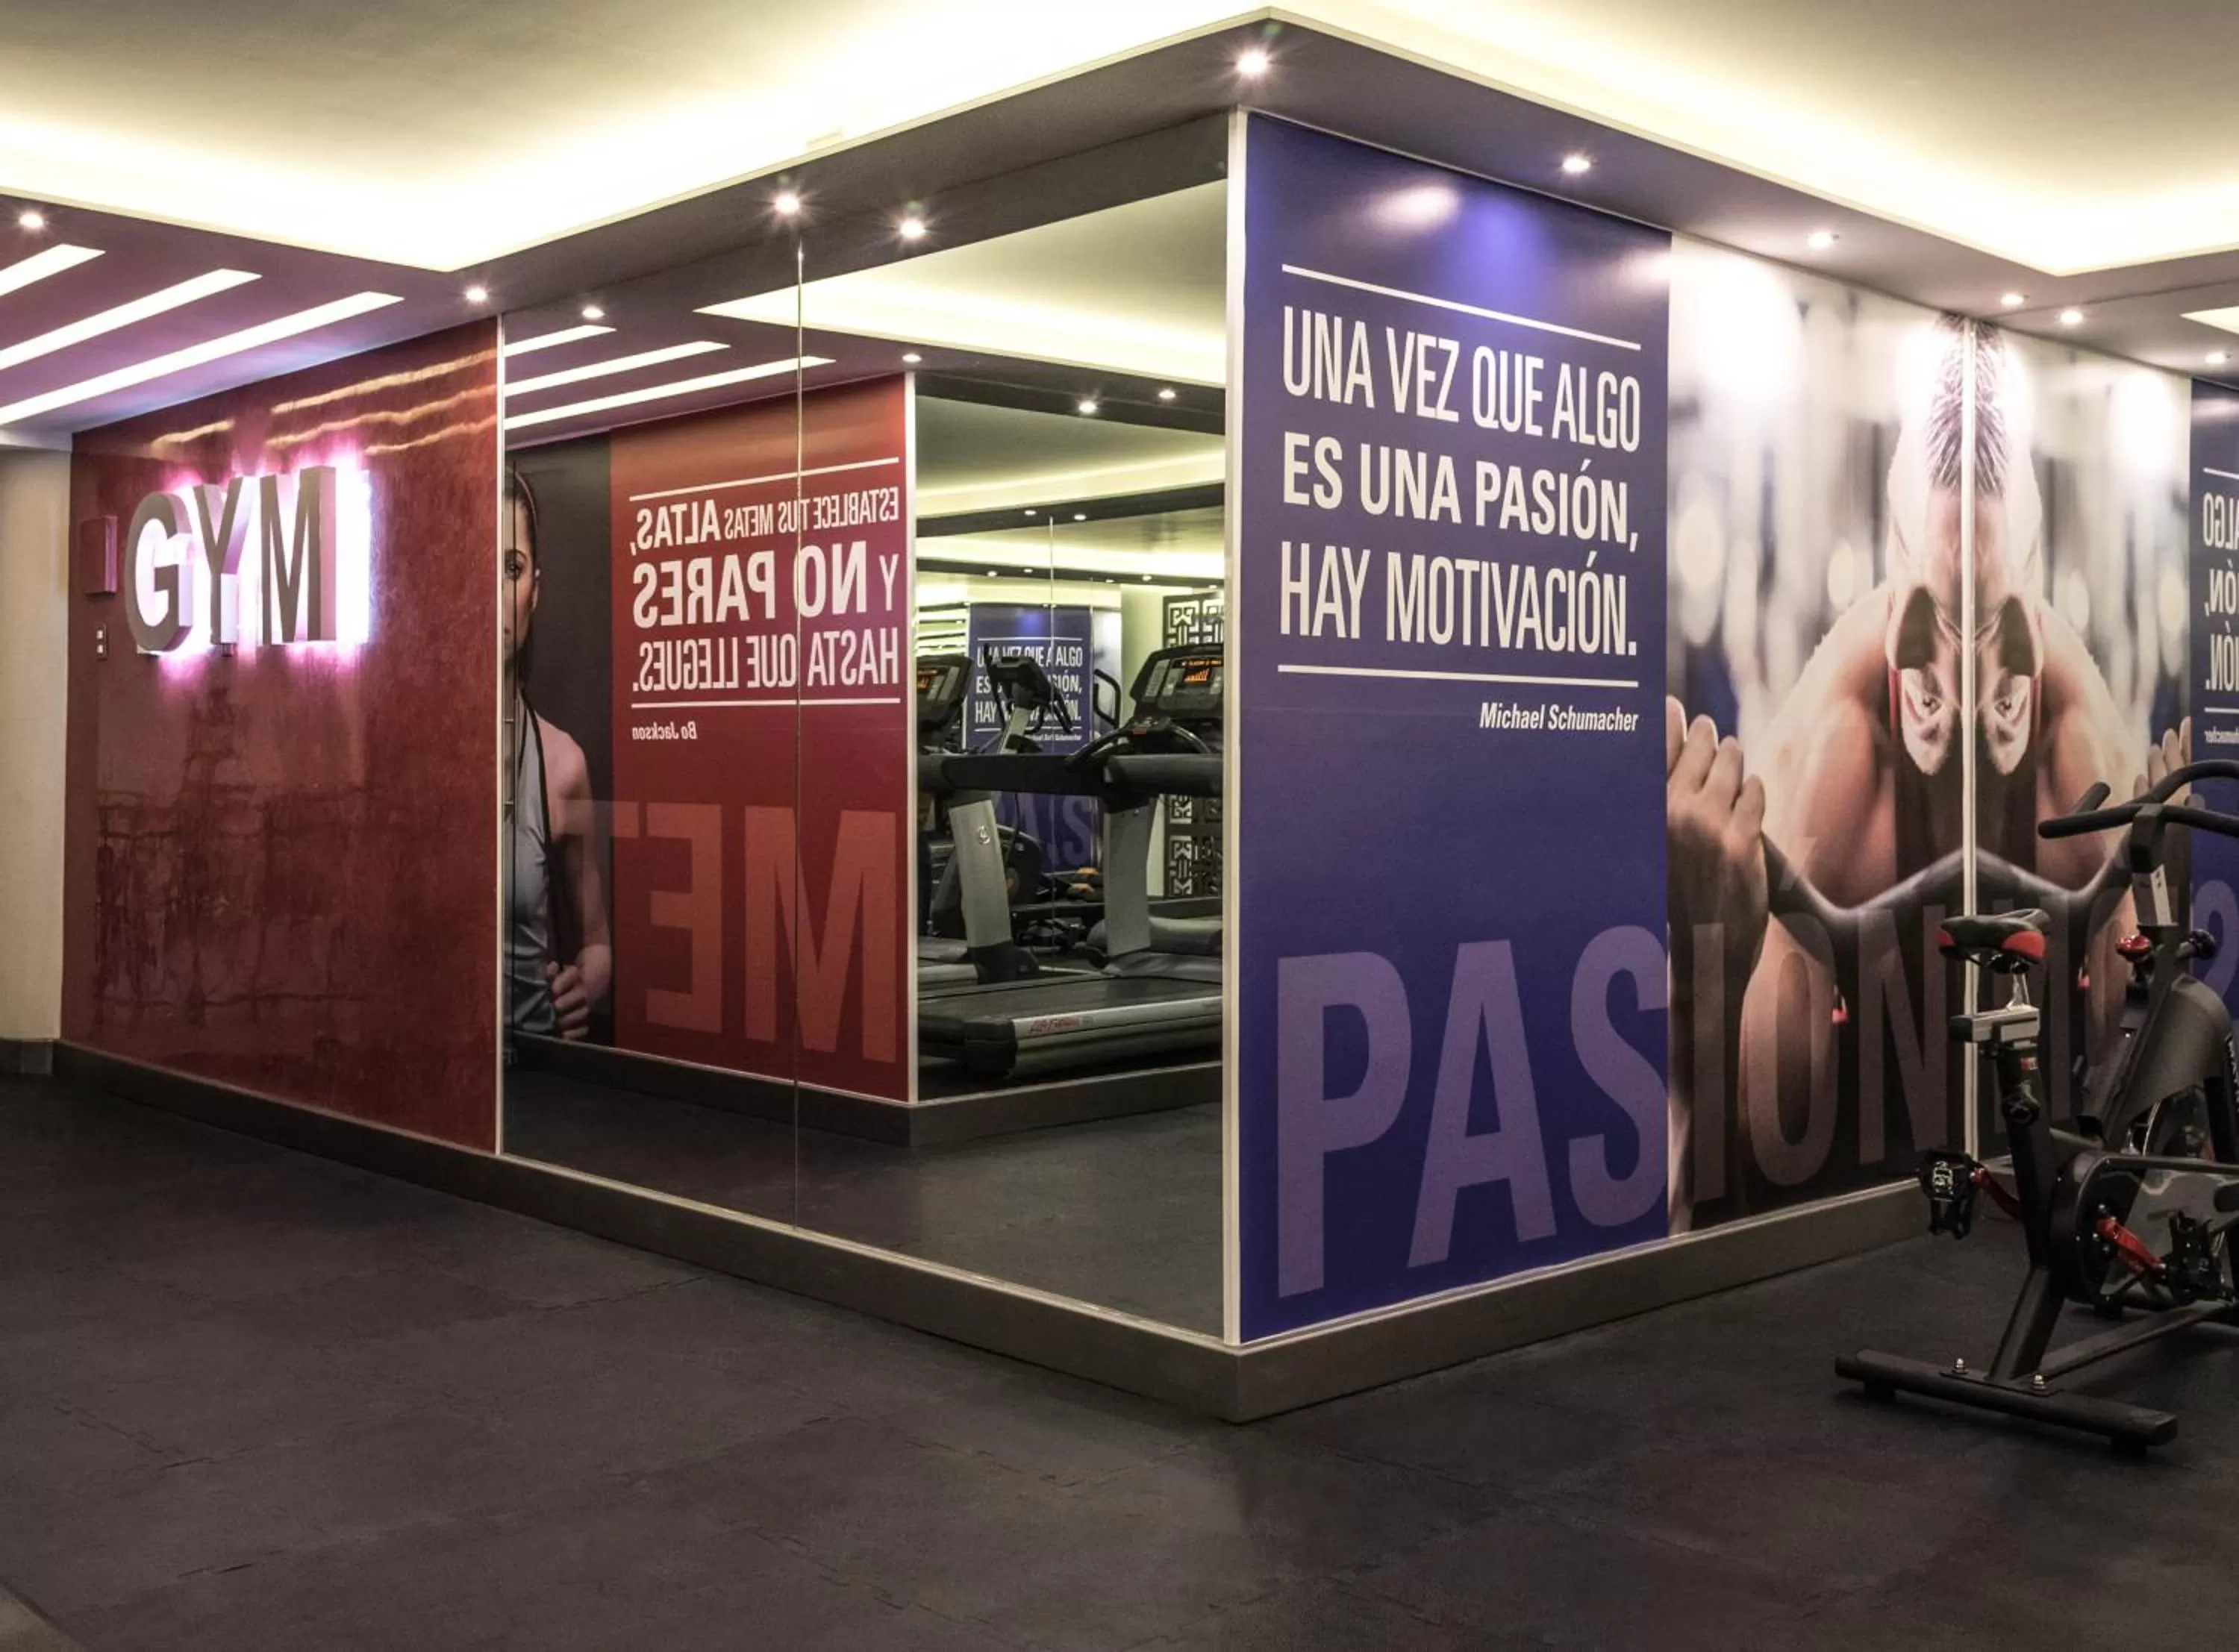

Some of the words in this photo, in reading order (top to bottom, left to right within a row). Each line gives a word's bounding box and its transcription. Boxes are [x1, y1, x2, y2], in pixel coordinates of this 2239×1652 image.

[1283, 305, 1375, 408] UNA
[1386, 326, 1460, 423] VEZ
[1472, 345, 1544, 437] QUE
[1552, 363, 1641, 452] ALGO
[1283, 431, 1343, 510] ES
[1360, 442, 1462, 524] UNA
[1476, 459, 1639, 553] PASIÓN,
[124, 465, 337, 653] GYM
[1280, 541, 1371, 640] HAY
[1386, 551, 1637, 657] MOTIVACIÓN.
[1479, 701, 1546, 730] Michael
[1547, 703, 1640, 732] Schumacher
